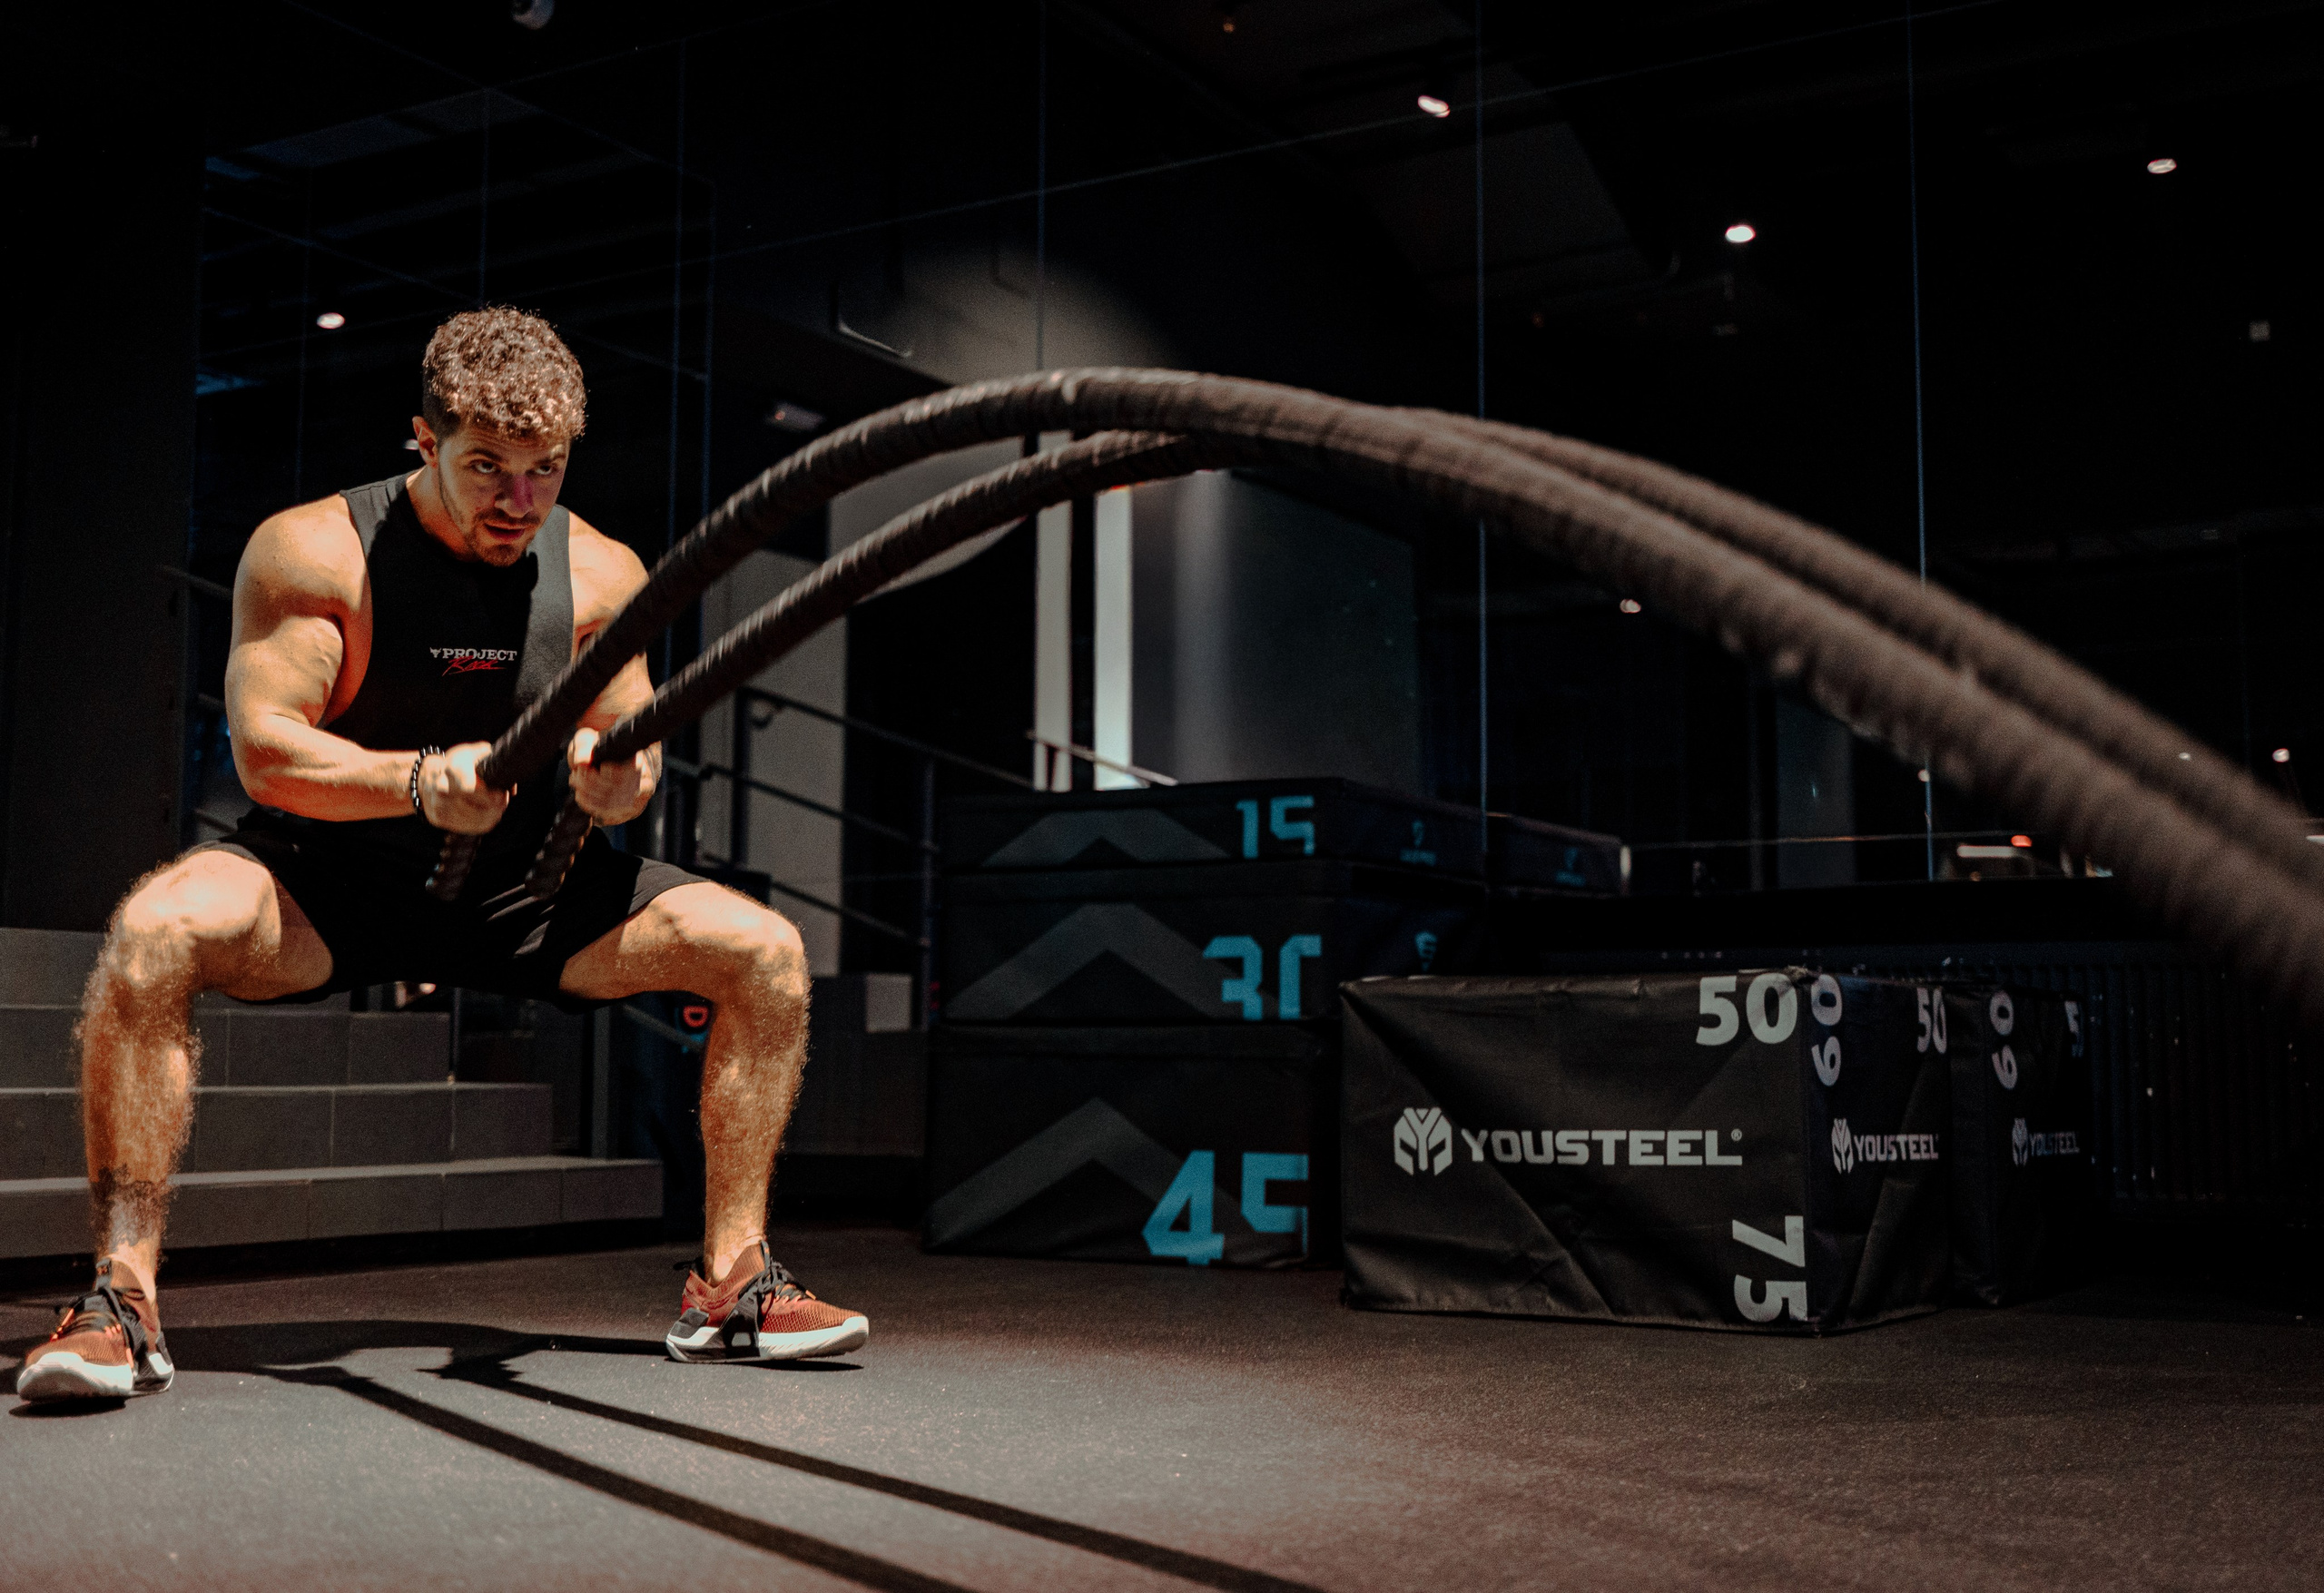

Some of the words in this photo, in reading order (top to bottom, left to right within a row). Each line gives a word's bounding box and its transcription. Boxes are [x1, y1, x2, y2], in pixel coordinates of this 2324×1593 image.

[442, 648, 517, 662] PROJECT
[1235, 794, 1315, 860] 15
[1696, 972, 1798, 1046] 50
[1916, 986, 1947, 1054] 50
[1461, 1127, 1742, 1166] YOUSTEEL
[1853, 1133, 1939, 1162] YOUSTEEL
[1141, 1149, 1310, 1267] 45
[1732, 1214, 1809, 1323] 75
